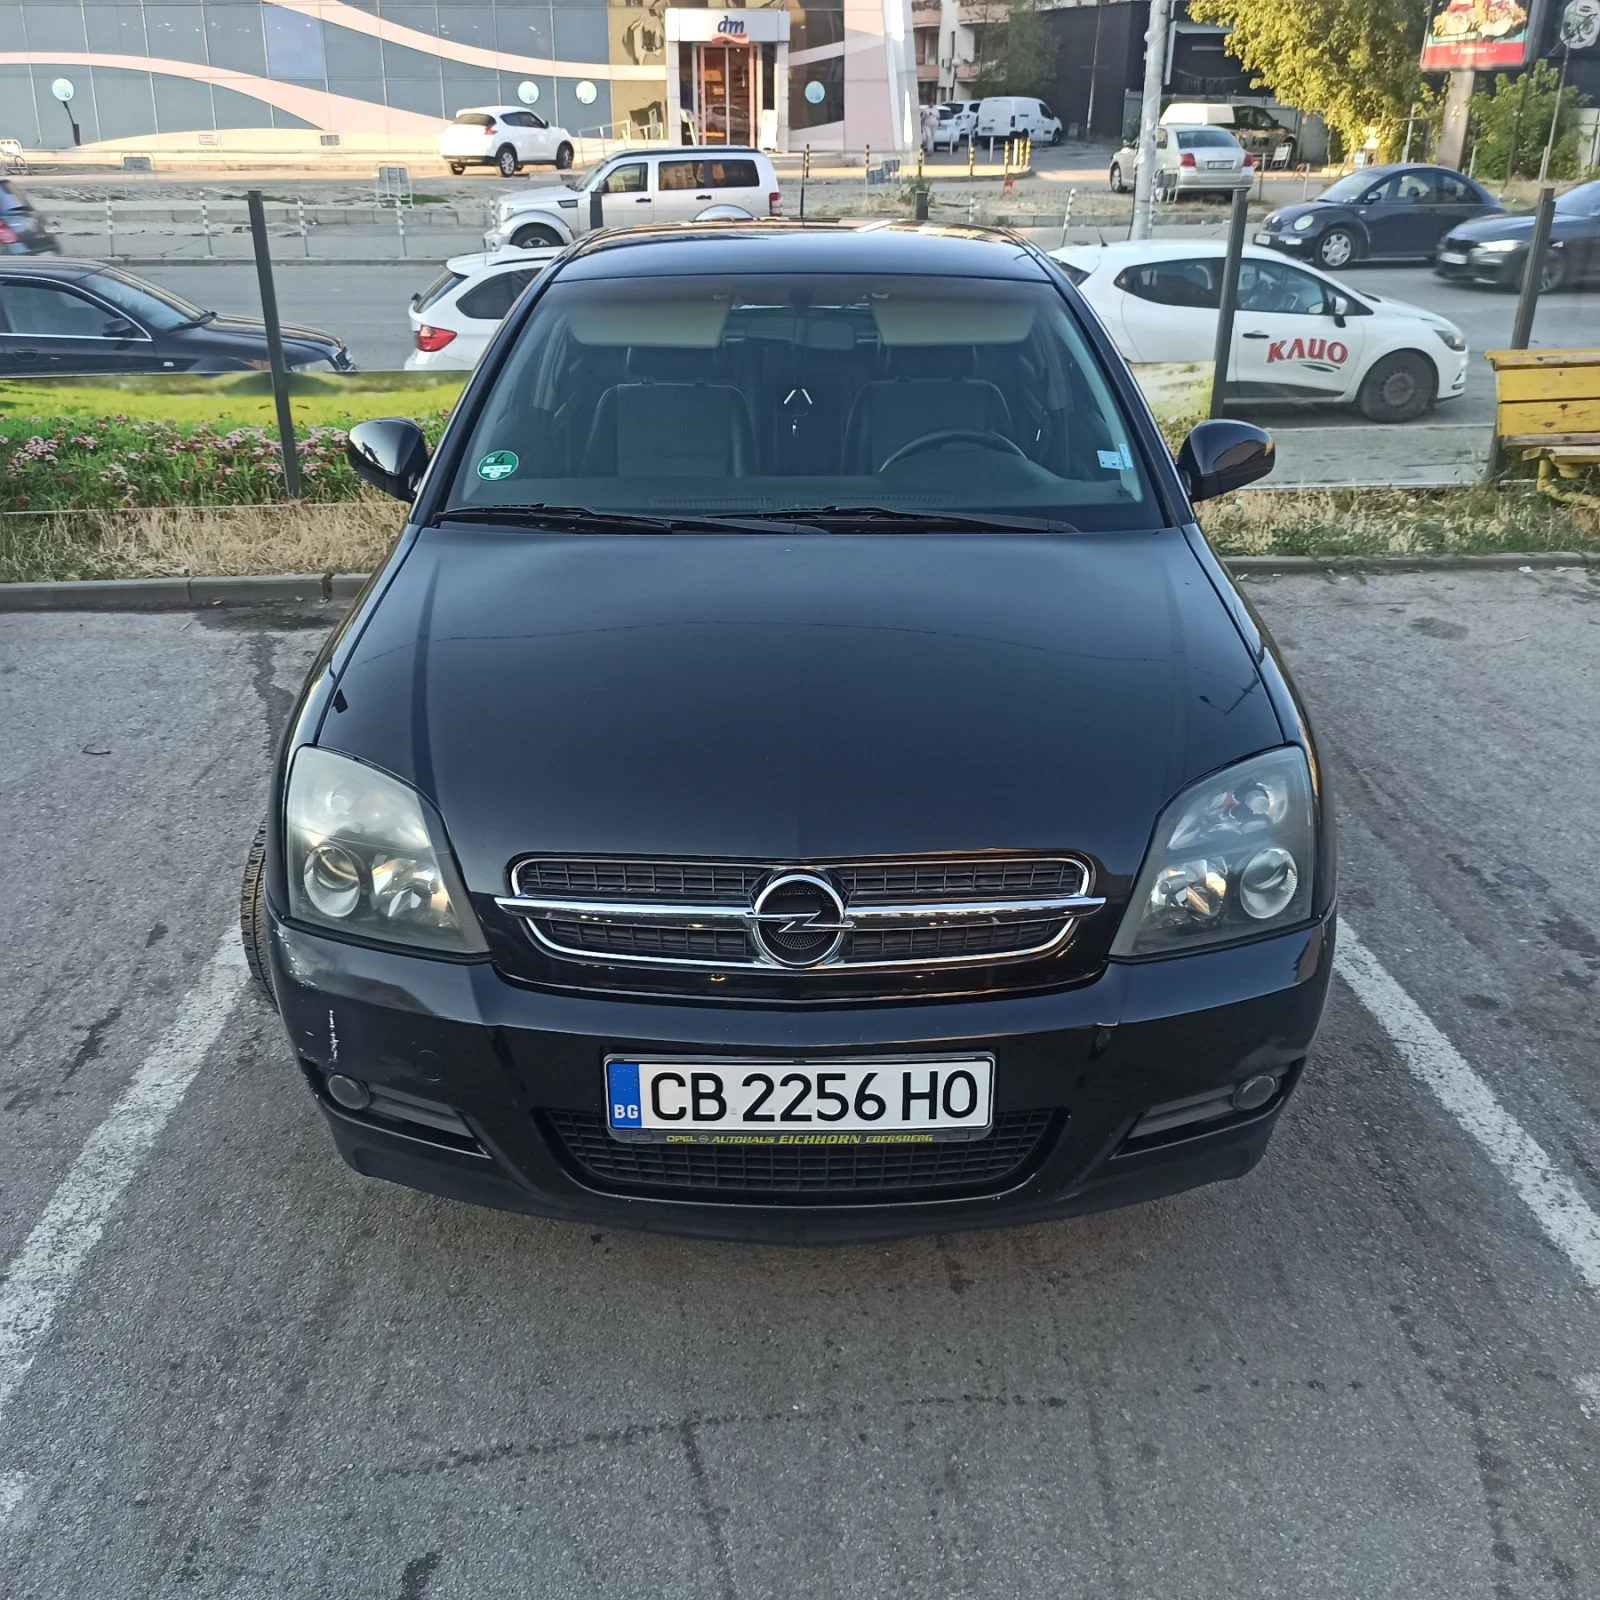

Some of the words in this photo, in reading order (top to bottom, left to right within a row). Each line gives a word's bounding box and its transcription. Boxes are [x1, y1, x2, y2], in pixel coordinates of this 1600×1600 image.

[717, 15, 745, 34] dm
[494, 452, 505, 465] 4
[650, 1071, 728, 1122] CB
[741, 1072, 887, 1122] 2256
[901, 1070, 978, 1121] HO
[613, 1104, 639, 1119] BG
[666, 1135, 698, 1143] OPEL
[711, 1135, 775, 1144] AUTOHAUS
[778, 1134, 861, 1145] EICHHORN
[865, 1134, 934, 1143] EBERSBERG
